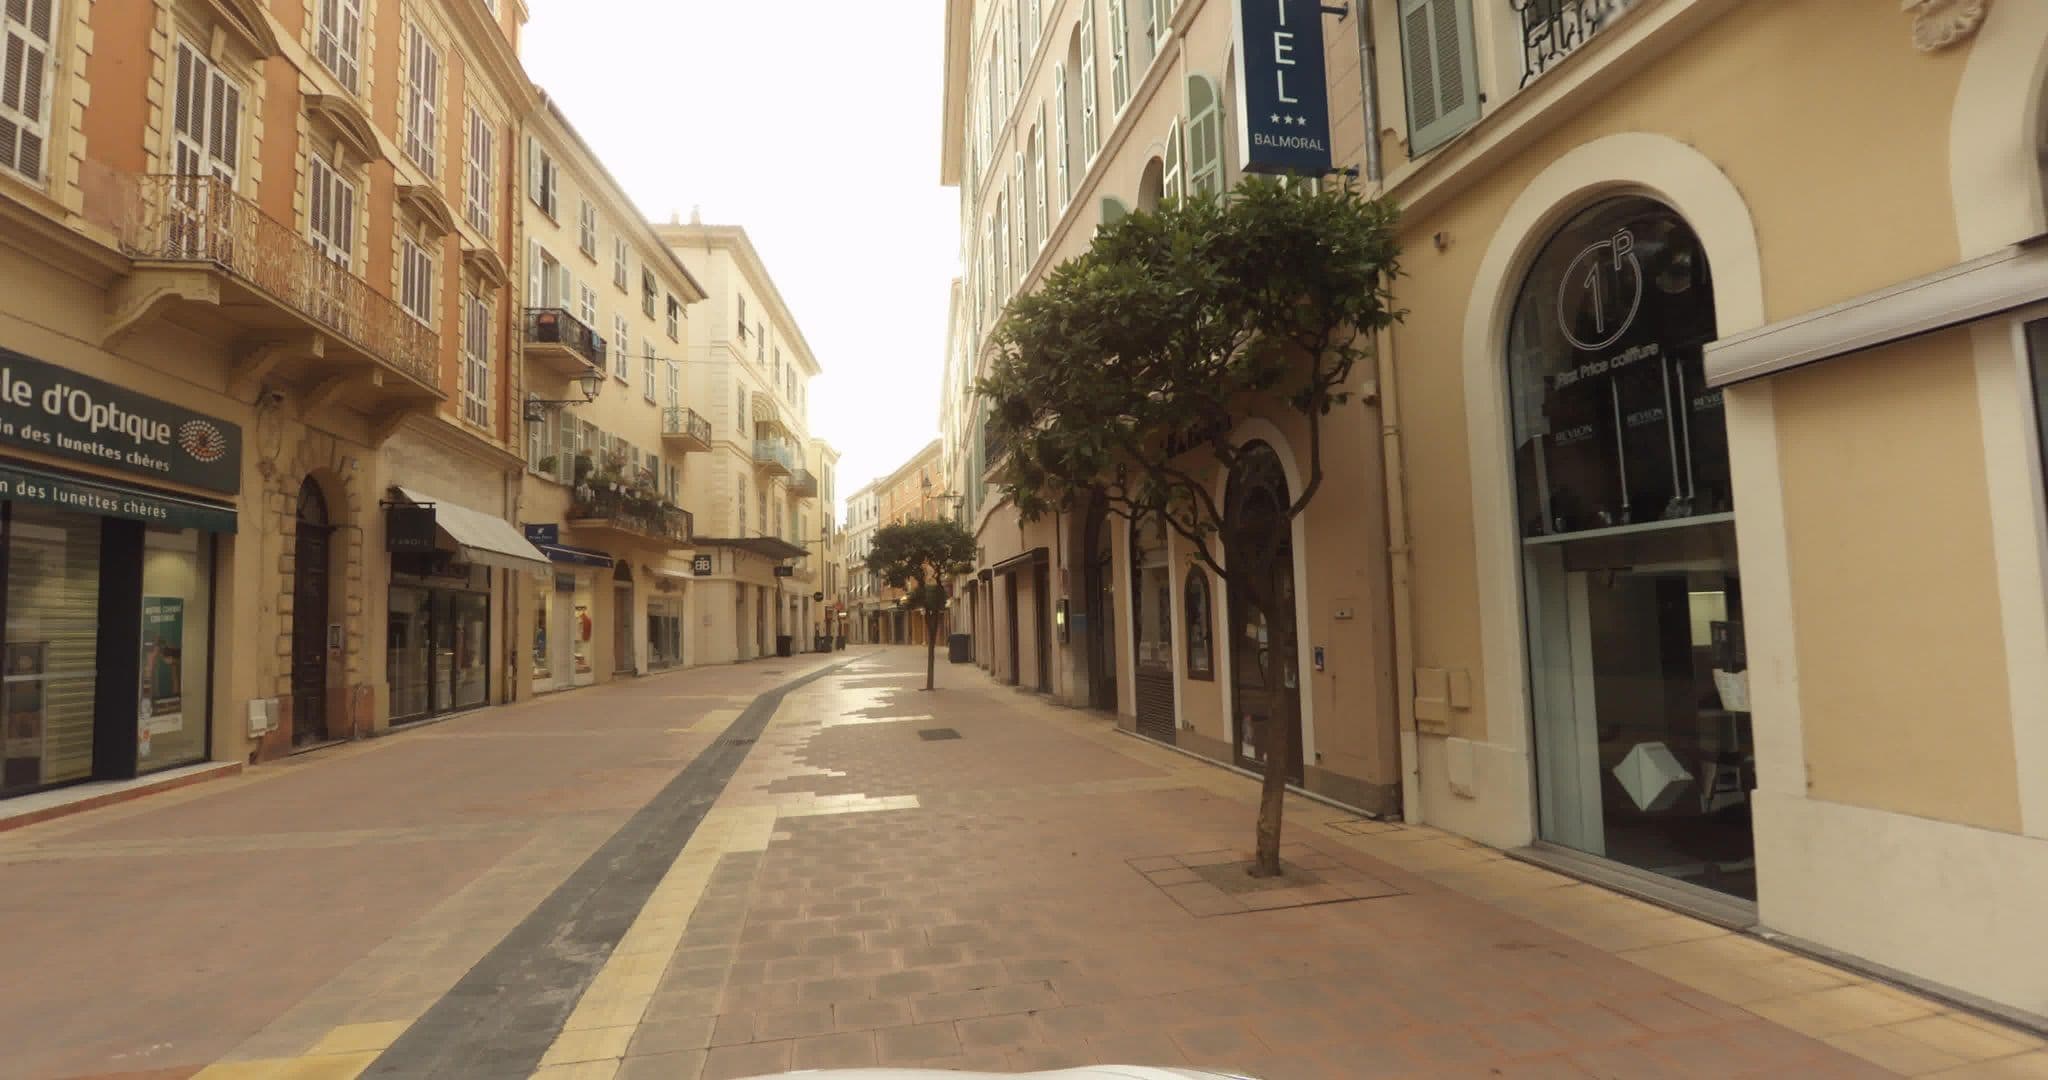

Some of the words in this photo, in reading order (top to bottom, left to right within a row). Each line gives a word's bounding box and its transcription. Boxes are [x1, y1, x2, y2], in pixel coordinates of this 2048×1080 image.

[1254, 133, 1324, 151] BALMORAL
[1580, 361, 1609, 379] Price
[42, 383, 171, 445] d'Optique
[21, 425, 51, 444] des
[56, 433, 122, 461] lunettes
[126, 453, 170, 472] chères
[16, 480, 46, 499] des
[53, 487, 118, 511] lunettes
[123, 500, 168, 518] chères
